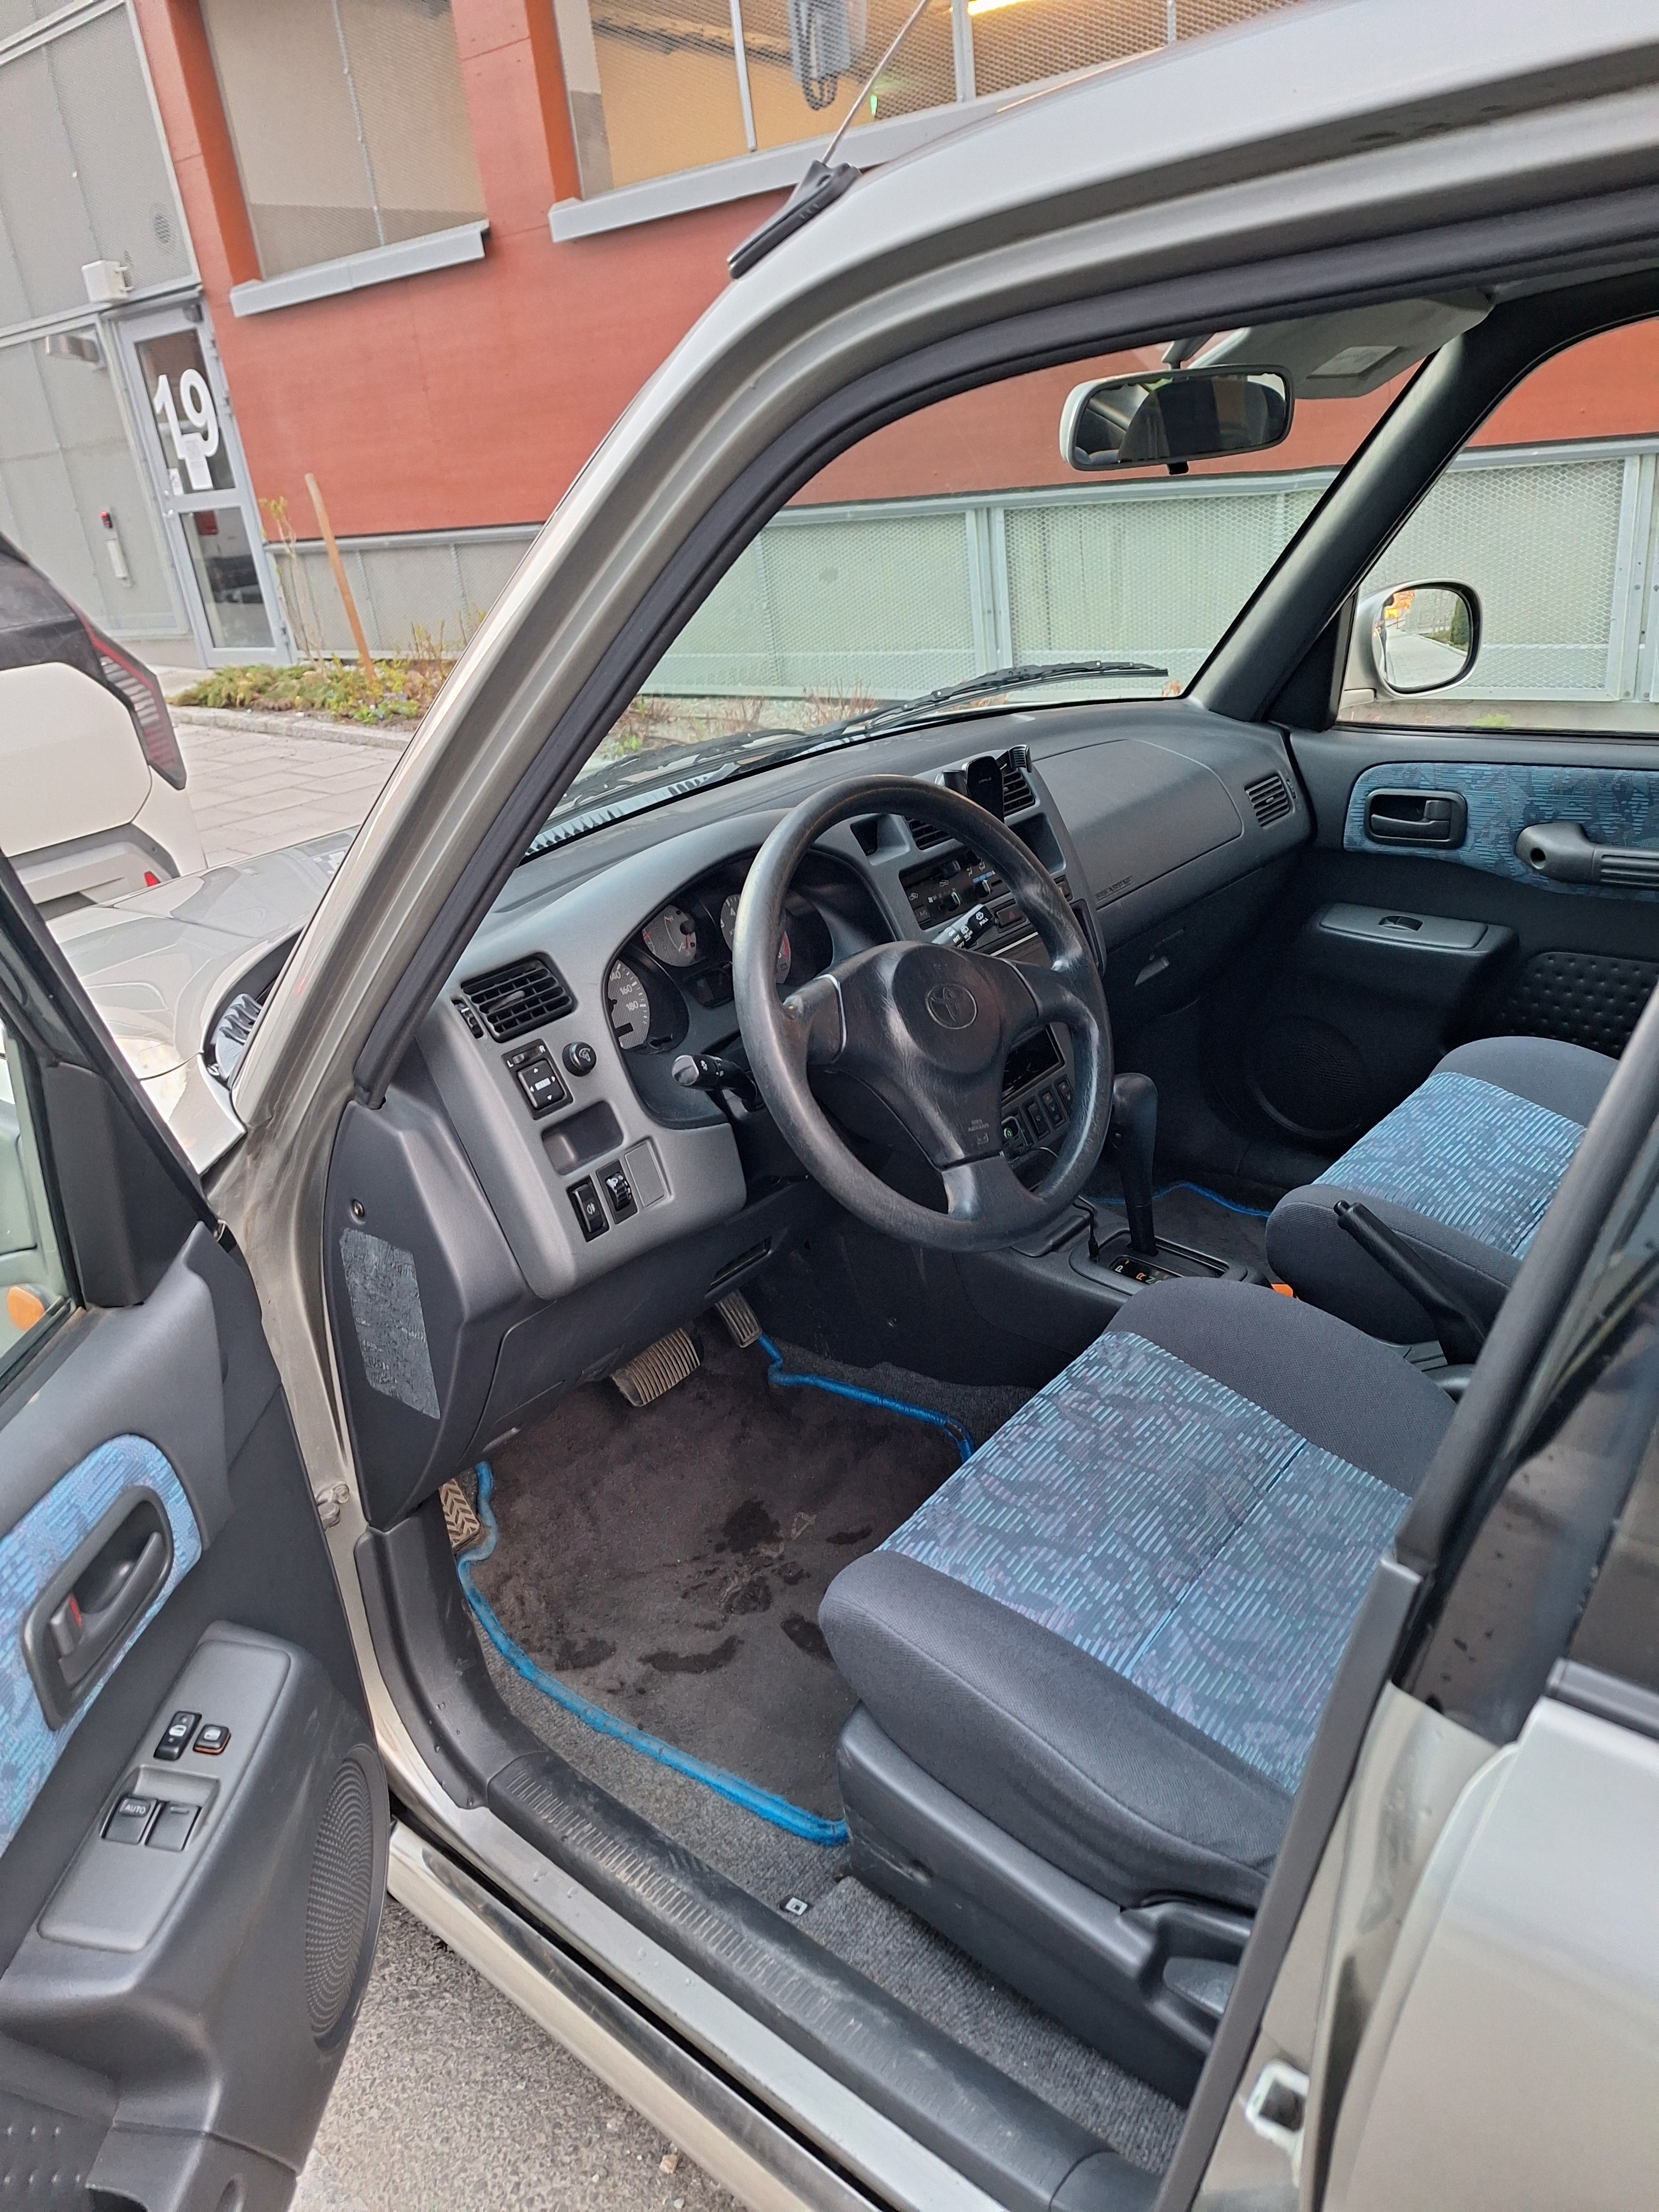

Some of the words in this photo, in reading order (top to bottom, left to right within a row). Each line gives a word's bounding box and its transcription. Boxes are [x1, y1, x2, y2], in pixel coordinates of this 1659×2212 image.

[153, 369, 219, 459] 19
[609, 970, 621, 982] 140
[620, 984, 633, 995] 160
[626, 1000, 639, 1012] 180
[539, 1045, 546, 1053] R
[1115, 1265, 1123, 1273] P
[124, 1804, 146, 1815] AUTO
